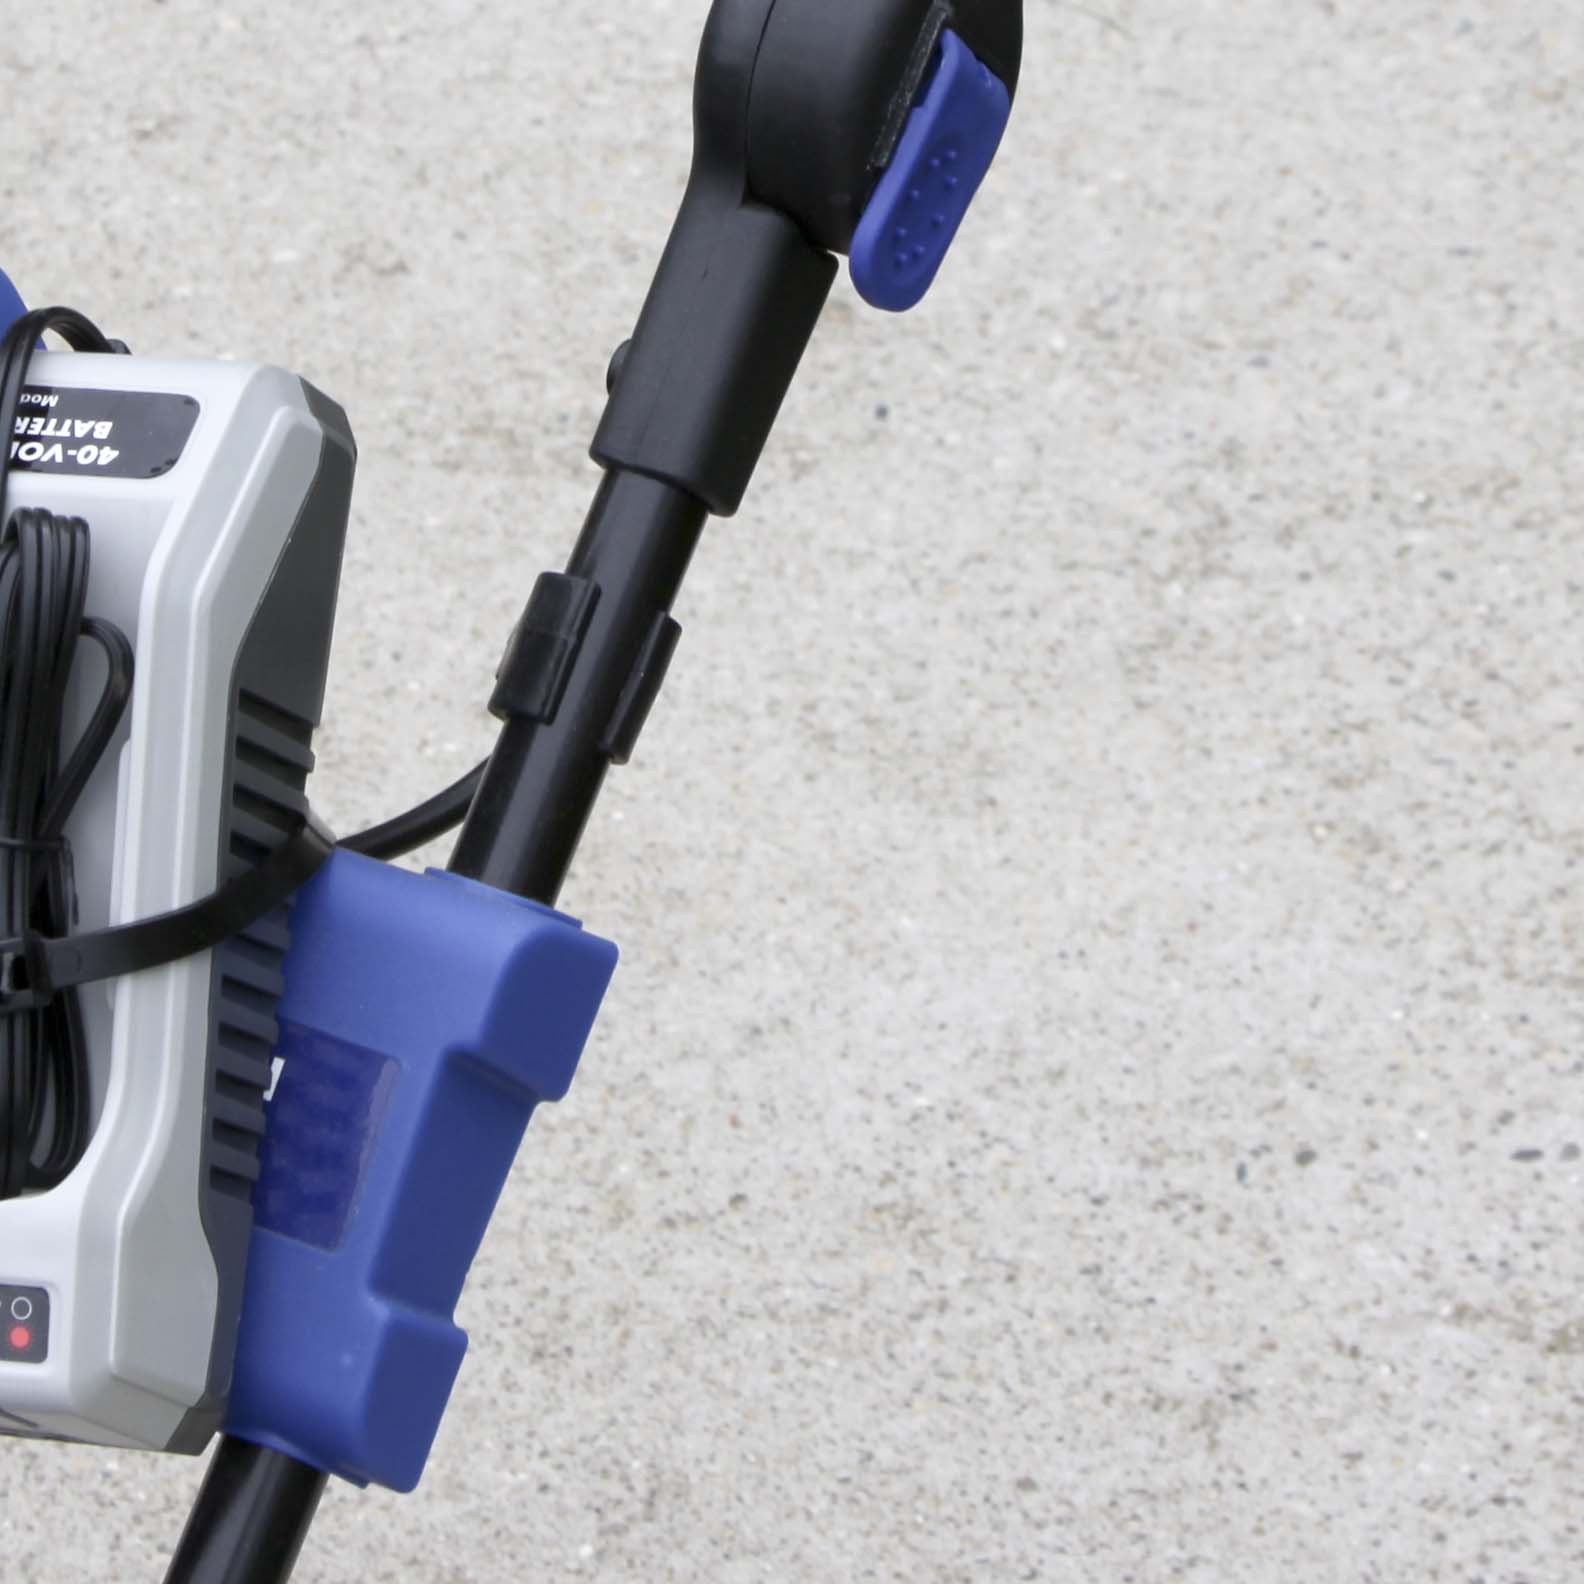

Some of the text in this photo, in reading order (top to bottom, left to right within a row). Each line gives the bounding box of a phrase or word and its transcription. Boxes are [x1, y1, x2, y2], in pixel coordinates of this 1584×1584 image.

[19, 393, 59, 407] Mod
[14, 416, 113, 440] BATTER
[10, 441, 120, 465] 40-VO
